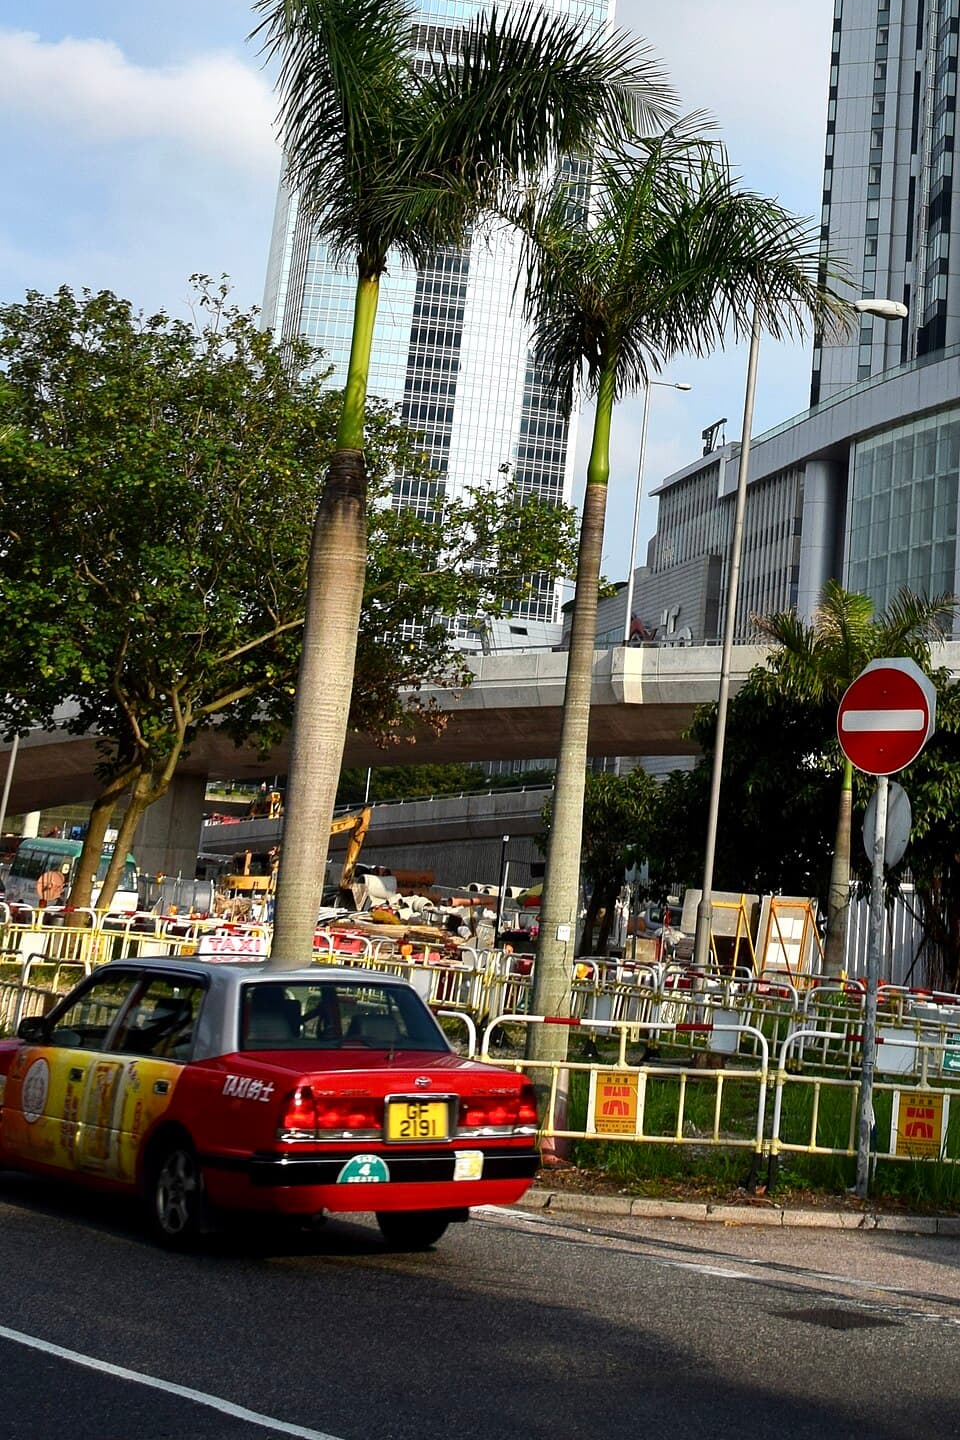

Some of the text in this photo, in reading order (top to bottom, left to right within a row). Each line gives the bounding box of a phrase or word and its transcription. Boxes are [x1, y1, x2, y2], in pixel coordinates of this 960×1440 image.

[208, 937, 261, 953] TAXI
[407, 1103, 430, 1120] GF
[400, 1119, 436, 1137] 2191
[359, 1163, 371, 1176] 4
